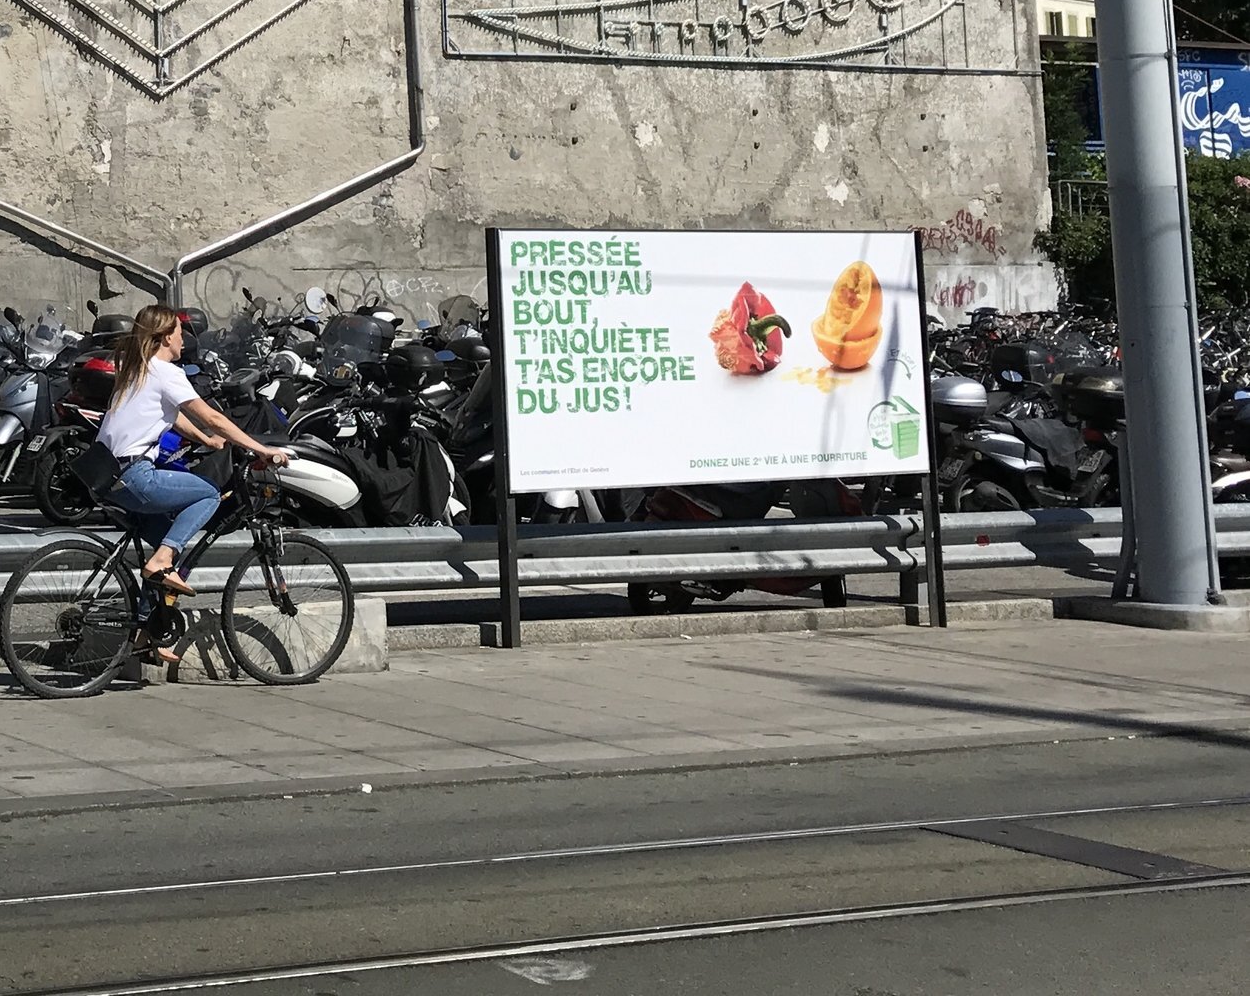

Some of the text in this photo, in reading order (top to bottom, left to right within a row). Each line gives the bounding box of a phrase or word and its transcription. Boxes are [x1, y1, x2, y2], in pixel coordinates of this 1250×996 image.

[510, 236, 642, 267] PRESSÉE
[511, 270, 652, 297] JUSQU'AU
[513, 299, 599, 331] BOUT,
[513, 322, 670, 355] T'INQUIÈTE
[515, 356, 696, 384] T'AS ENCORE
[517, 388, 559, 415] DU
[689, 459, 728, 469] DONNEZ
[731, 457, 750, 467] UNE
[764, 456, 779, 465] VIE
[790, 454, 809, 464] UNE
[811, 452, 868, 463] POURRITURE
